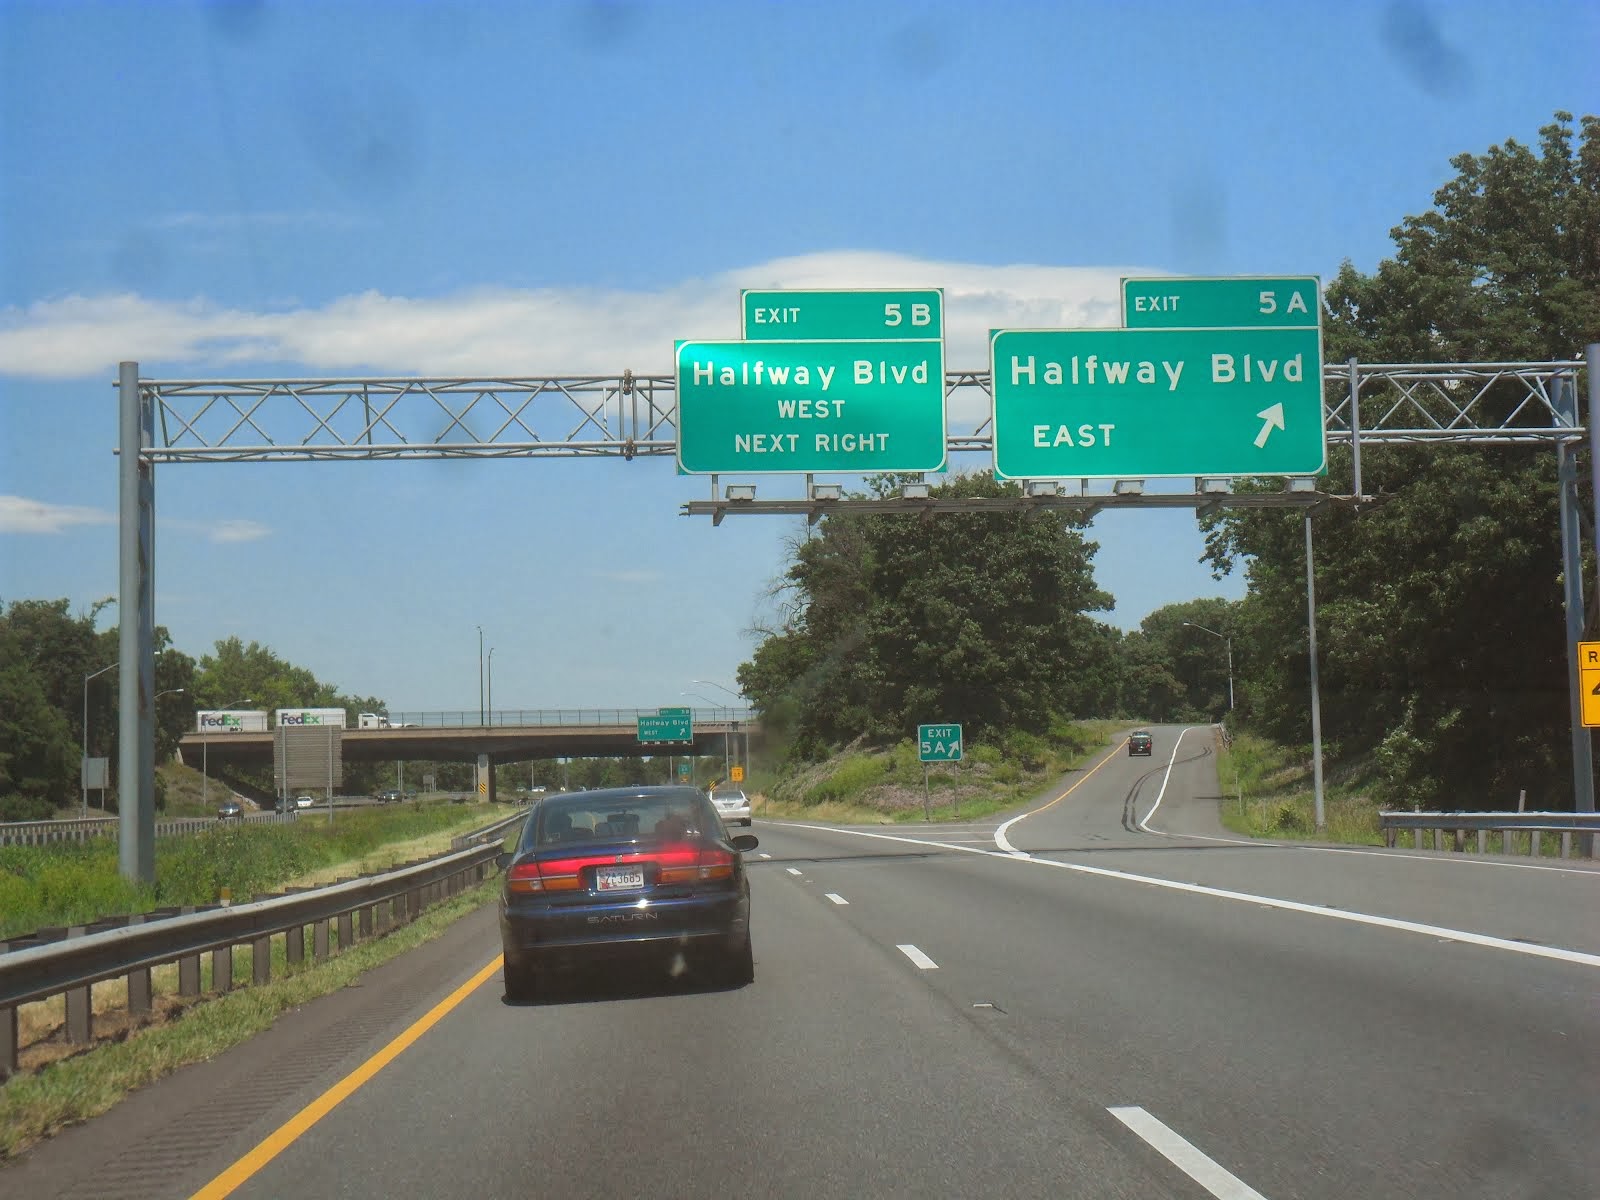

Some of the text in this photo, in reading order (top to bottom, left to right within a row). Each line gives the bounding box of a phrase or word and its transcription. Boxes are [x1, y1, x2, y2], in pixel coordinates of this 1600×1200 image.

[1135, 296, 1180, 312] EXIT
[754, 308, 800, 323] EXIT
[693, 360, 928, 391] Halfway Blvd
[1011, 353, 1303, 391] Halfway Blvd
[777, 400, 846, 418] WEST
[735, 433, 890, 453] NEXT RIGHT
[1033, 424, 1115, 447] EAST
[201, 714, 240, 726] FedEx
[281, 713, 319, 725] FedEx
[928, 729, 952, 738] EXIT
[587, 912, 657, 923] SATURN
